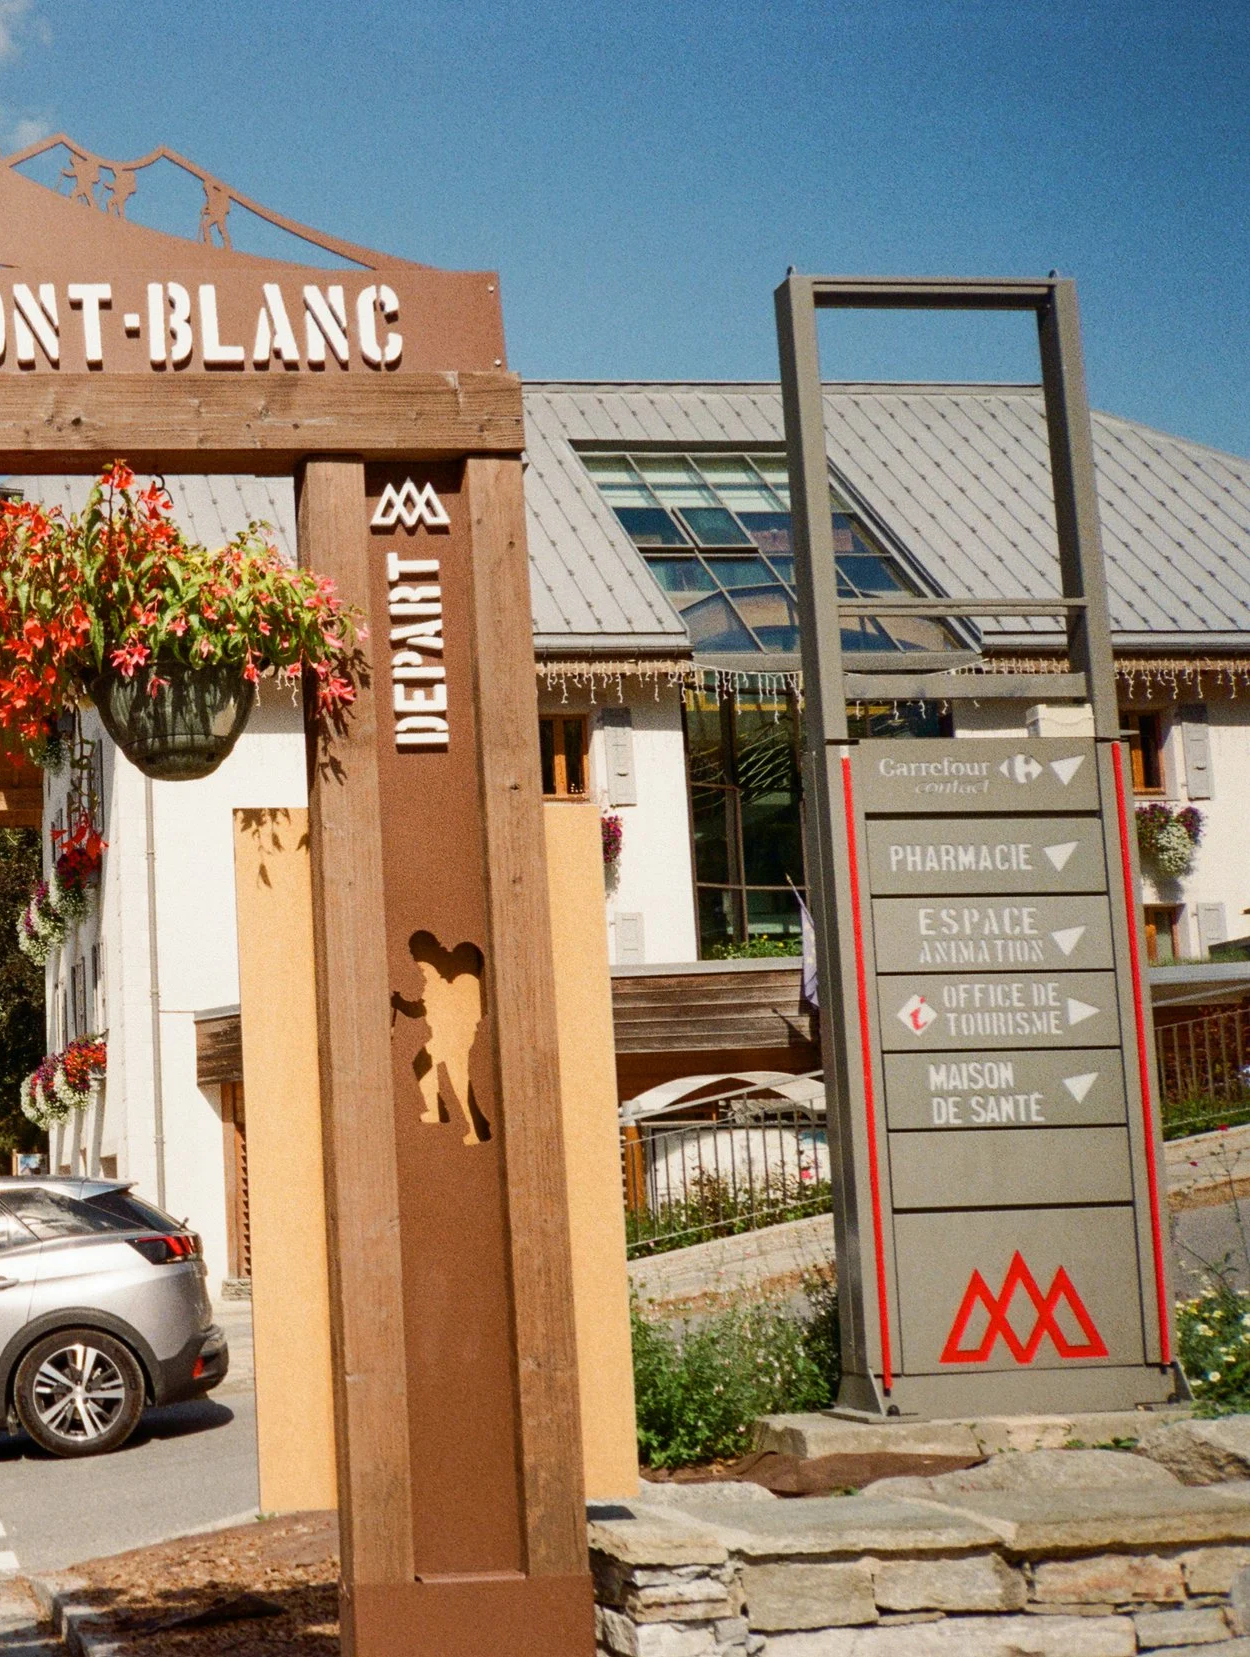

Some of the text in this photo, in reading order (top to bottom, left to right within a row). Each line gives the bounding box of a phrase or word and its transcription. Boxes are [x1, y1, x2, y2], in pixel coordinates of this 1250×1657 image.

[386, 551, 450, 745] DEPART
[879, 757, 990, 777] Carrefour
[915, 780, 990, 794] contact
[890, 844, 1033, 872] PHARMACIE
[919, 907, 1038, 935] ESPACE
[918, 938, 1045, 964] ANIMATION
[942, 982, 1061, 1008] OFFICE DE
[946, 1011, 1063, 1037] TOURISME
[928, 1062, 1015, 1091] MAISON
[932, 1092, 1045, 1124] DE SANTÉ
